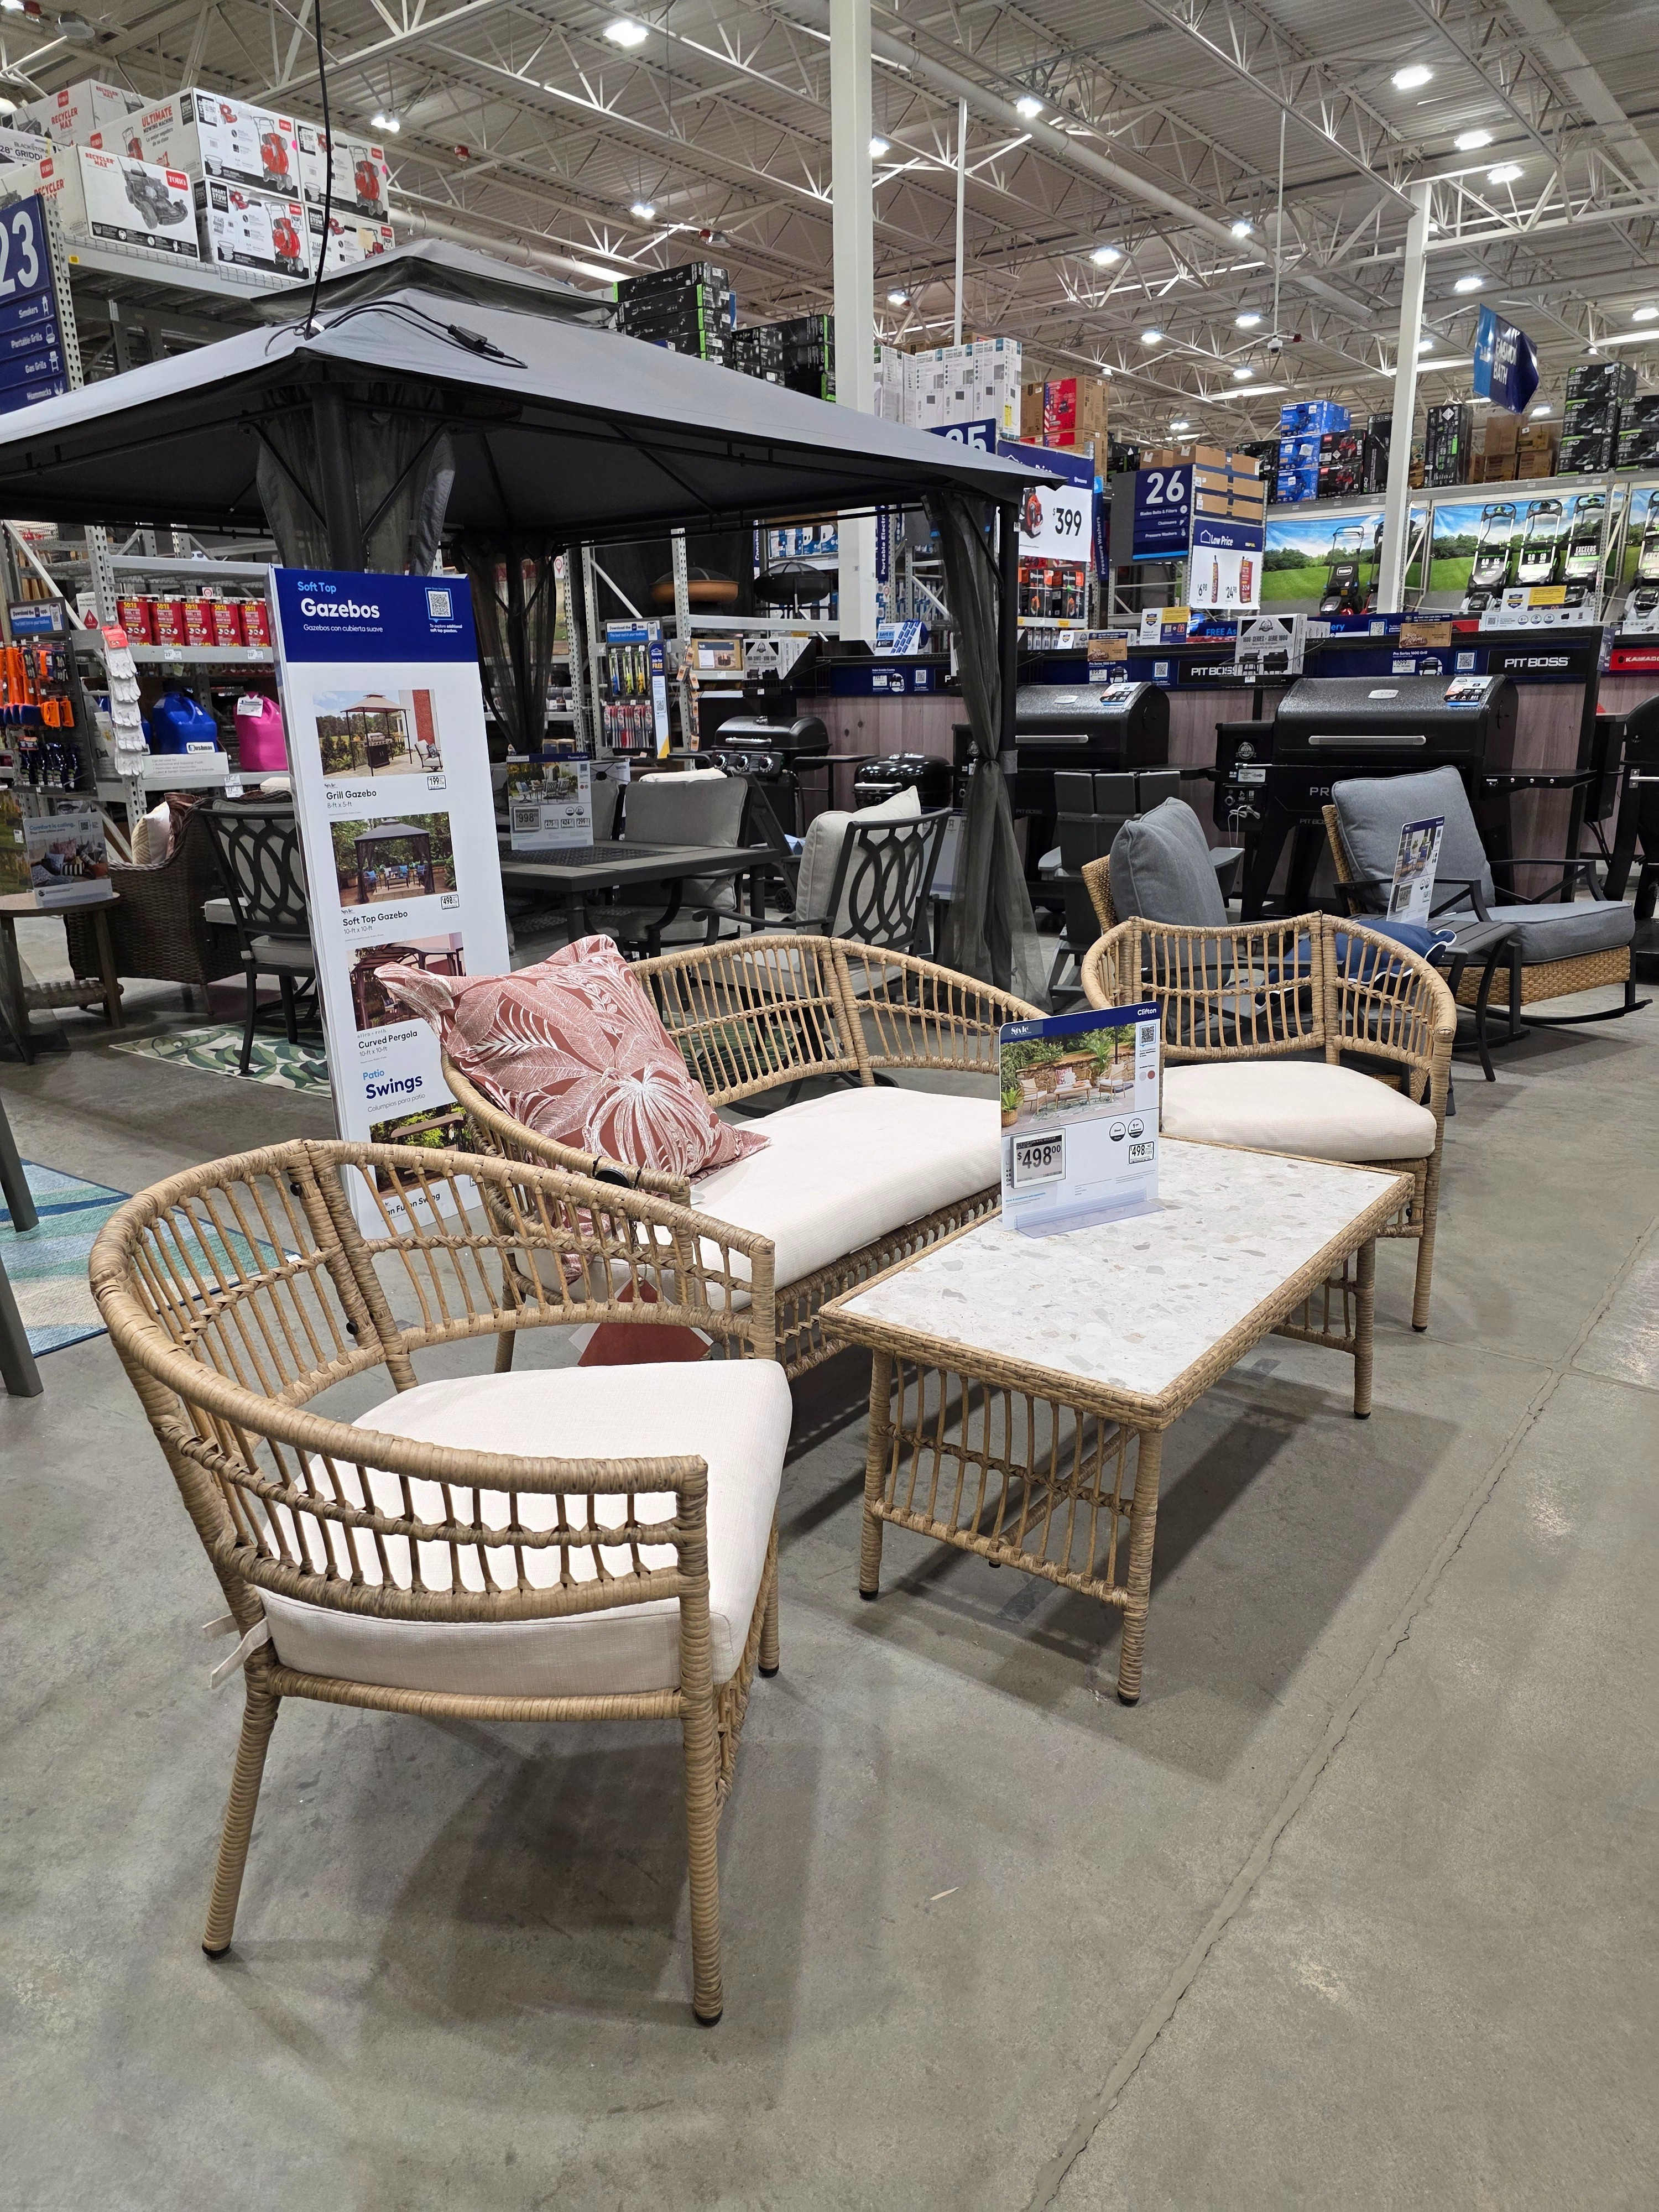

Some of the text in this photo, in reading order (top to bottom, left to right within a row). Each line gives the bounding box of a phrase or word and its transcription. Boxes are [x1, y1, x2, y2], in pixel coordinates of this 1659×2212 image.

[51, 107, 78, 125] RECYCLER
[142, 106, 173, 127] ULTIMATE
[60, 119, 72, 131] MAX
[15, 149, 43, 160] GRIDD
[85, 152, 114, 165] RECYCLER
[168, 175, 186, 187] TORO
[212, 192, 227, 201] STOW
[25, 360, 46, 374] Gas Grills
[1493, 361, 1509, 385] BATH
[1146, 470, 1185, 504] 26
[1052, 507, 1082, 536] $399
[1211, 535, 1233, 546] Low Price
[1575, 545, 1597, 554] EXCEEDS
[298, 581, 336, 594] Soft Top
[301, 598, 380, 618] Gazebos
[1505, 656, 1569, 668] PIT BOSS
[1191, 667, 1208, 676] PIT
[326, 789, 377, 800] Grill Gazebo
[1310, 787, 1329, 796] PR
[343, 911, 408, 926] Soft Top Gazebo
[1137, 1008, 1156, 1016] Clifton
[1011, 1026, 1029, 1036] Style
[358, 1030, 418, 1049] Curved Pergola
[363, 1069, 385, 1080] Patio
[366, 1076, 423, 1099] Swings
[367, 1093, 425, 1113] Columpios para patio
[396, 1201, 417, 1213] Fun
[419, 1193, 440, 1205] Swng
